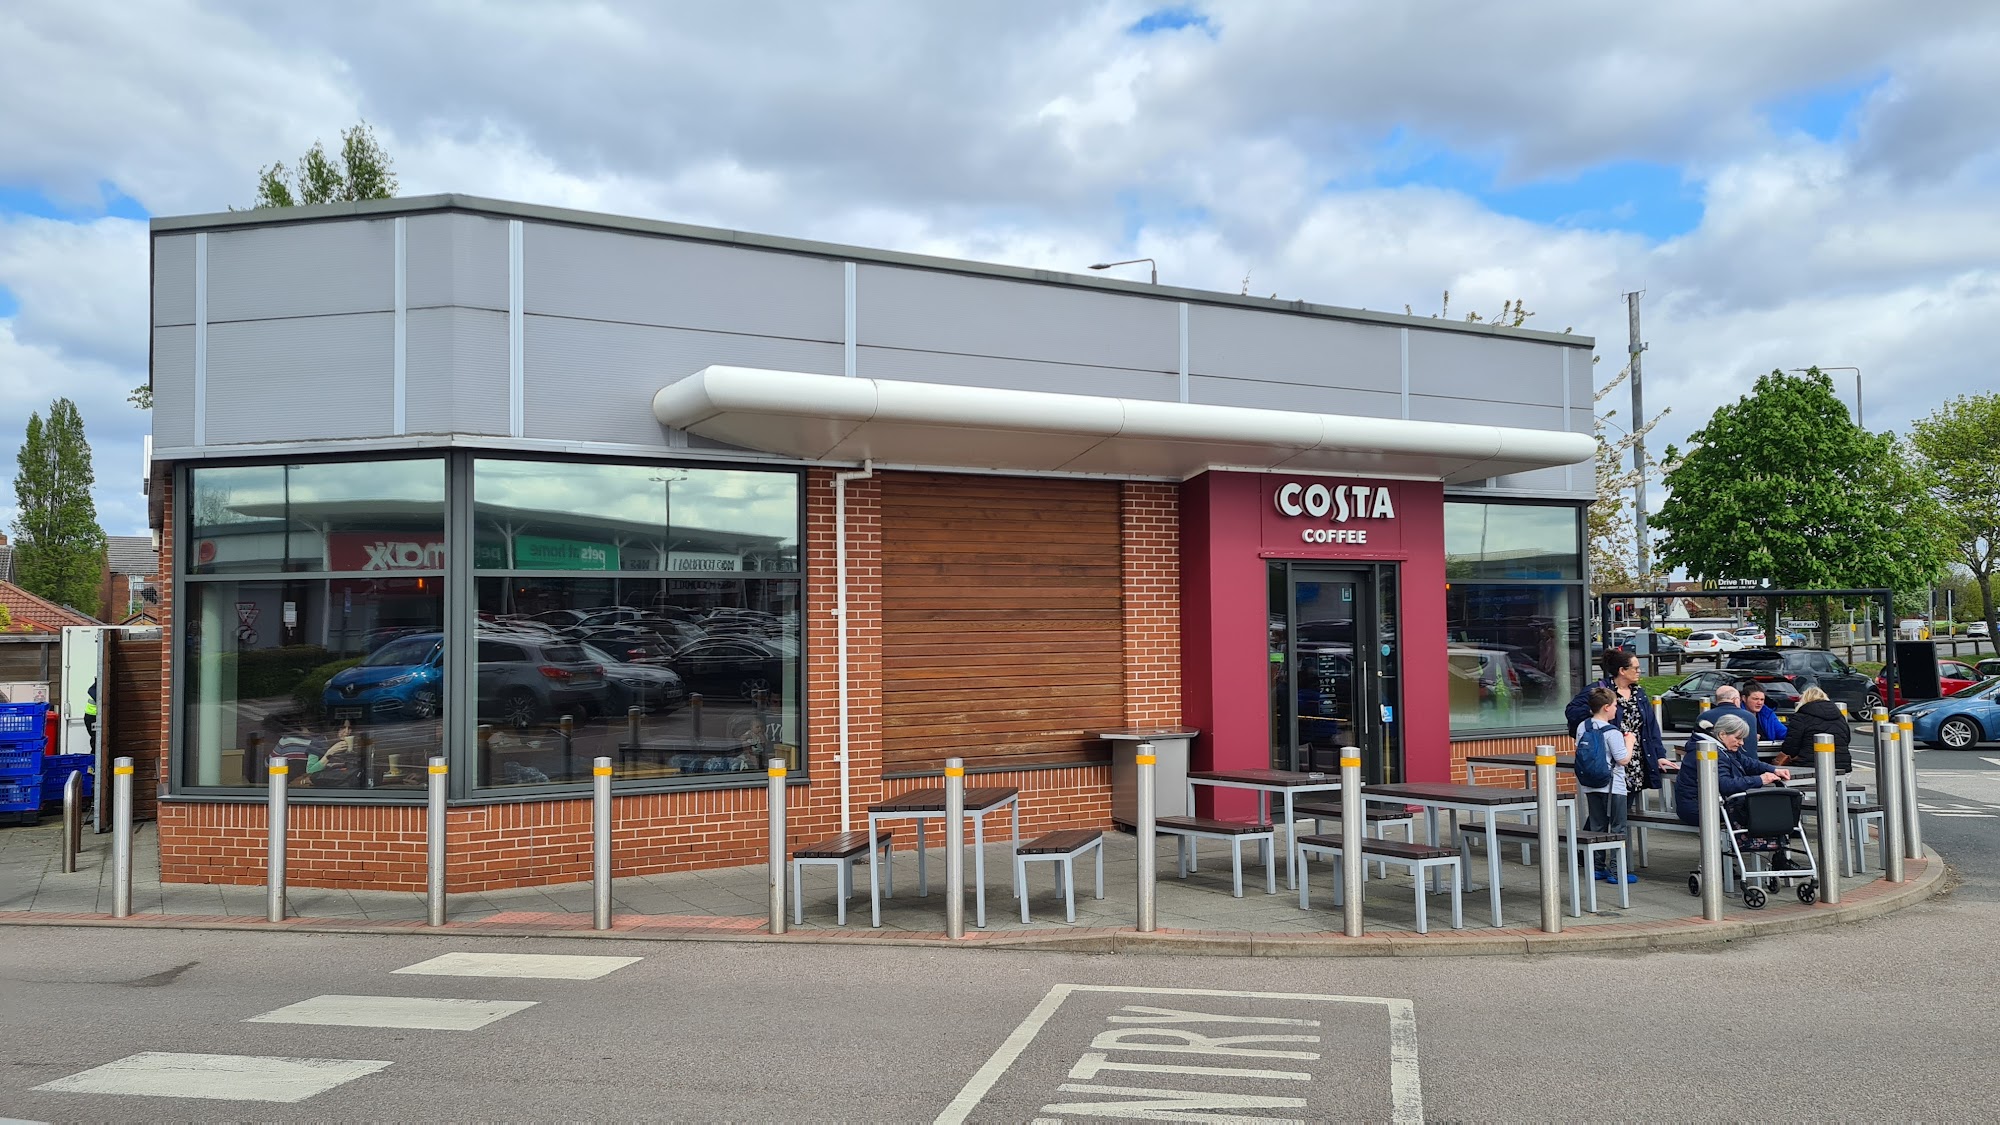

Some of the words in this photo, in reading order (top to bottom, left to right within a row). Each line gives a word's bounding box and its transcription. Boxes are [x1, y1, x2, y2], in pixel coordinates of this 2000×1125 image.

[1275, 482, 1395, 523] COSTA
[1302, 528, 1367, 544] COFFEE
[1718, 578, 1738, 586] Drive
[1739, 578, 1758, 586] Thru
